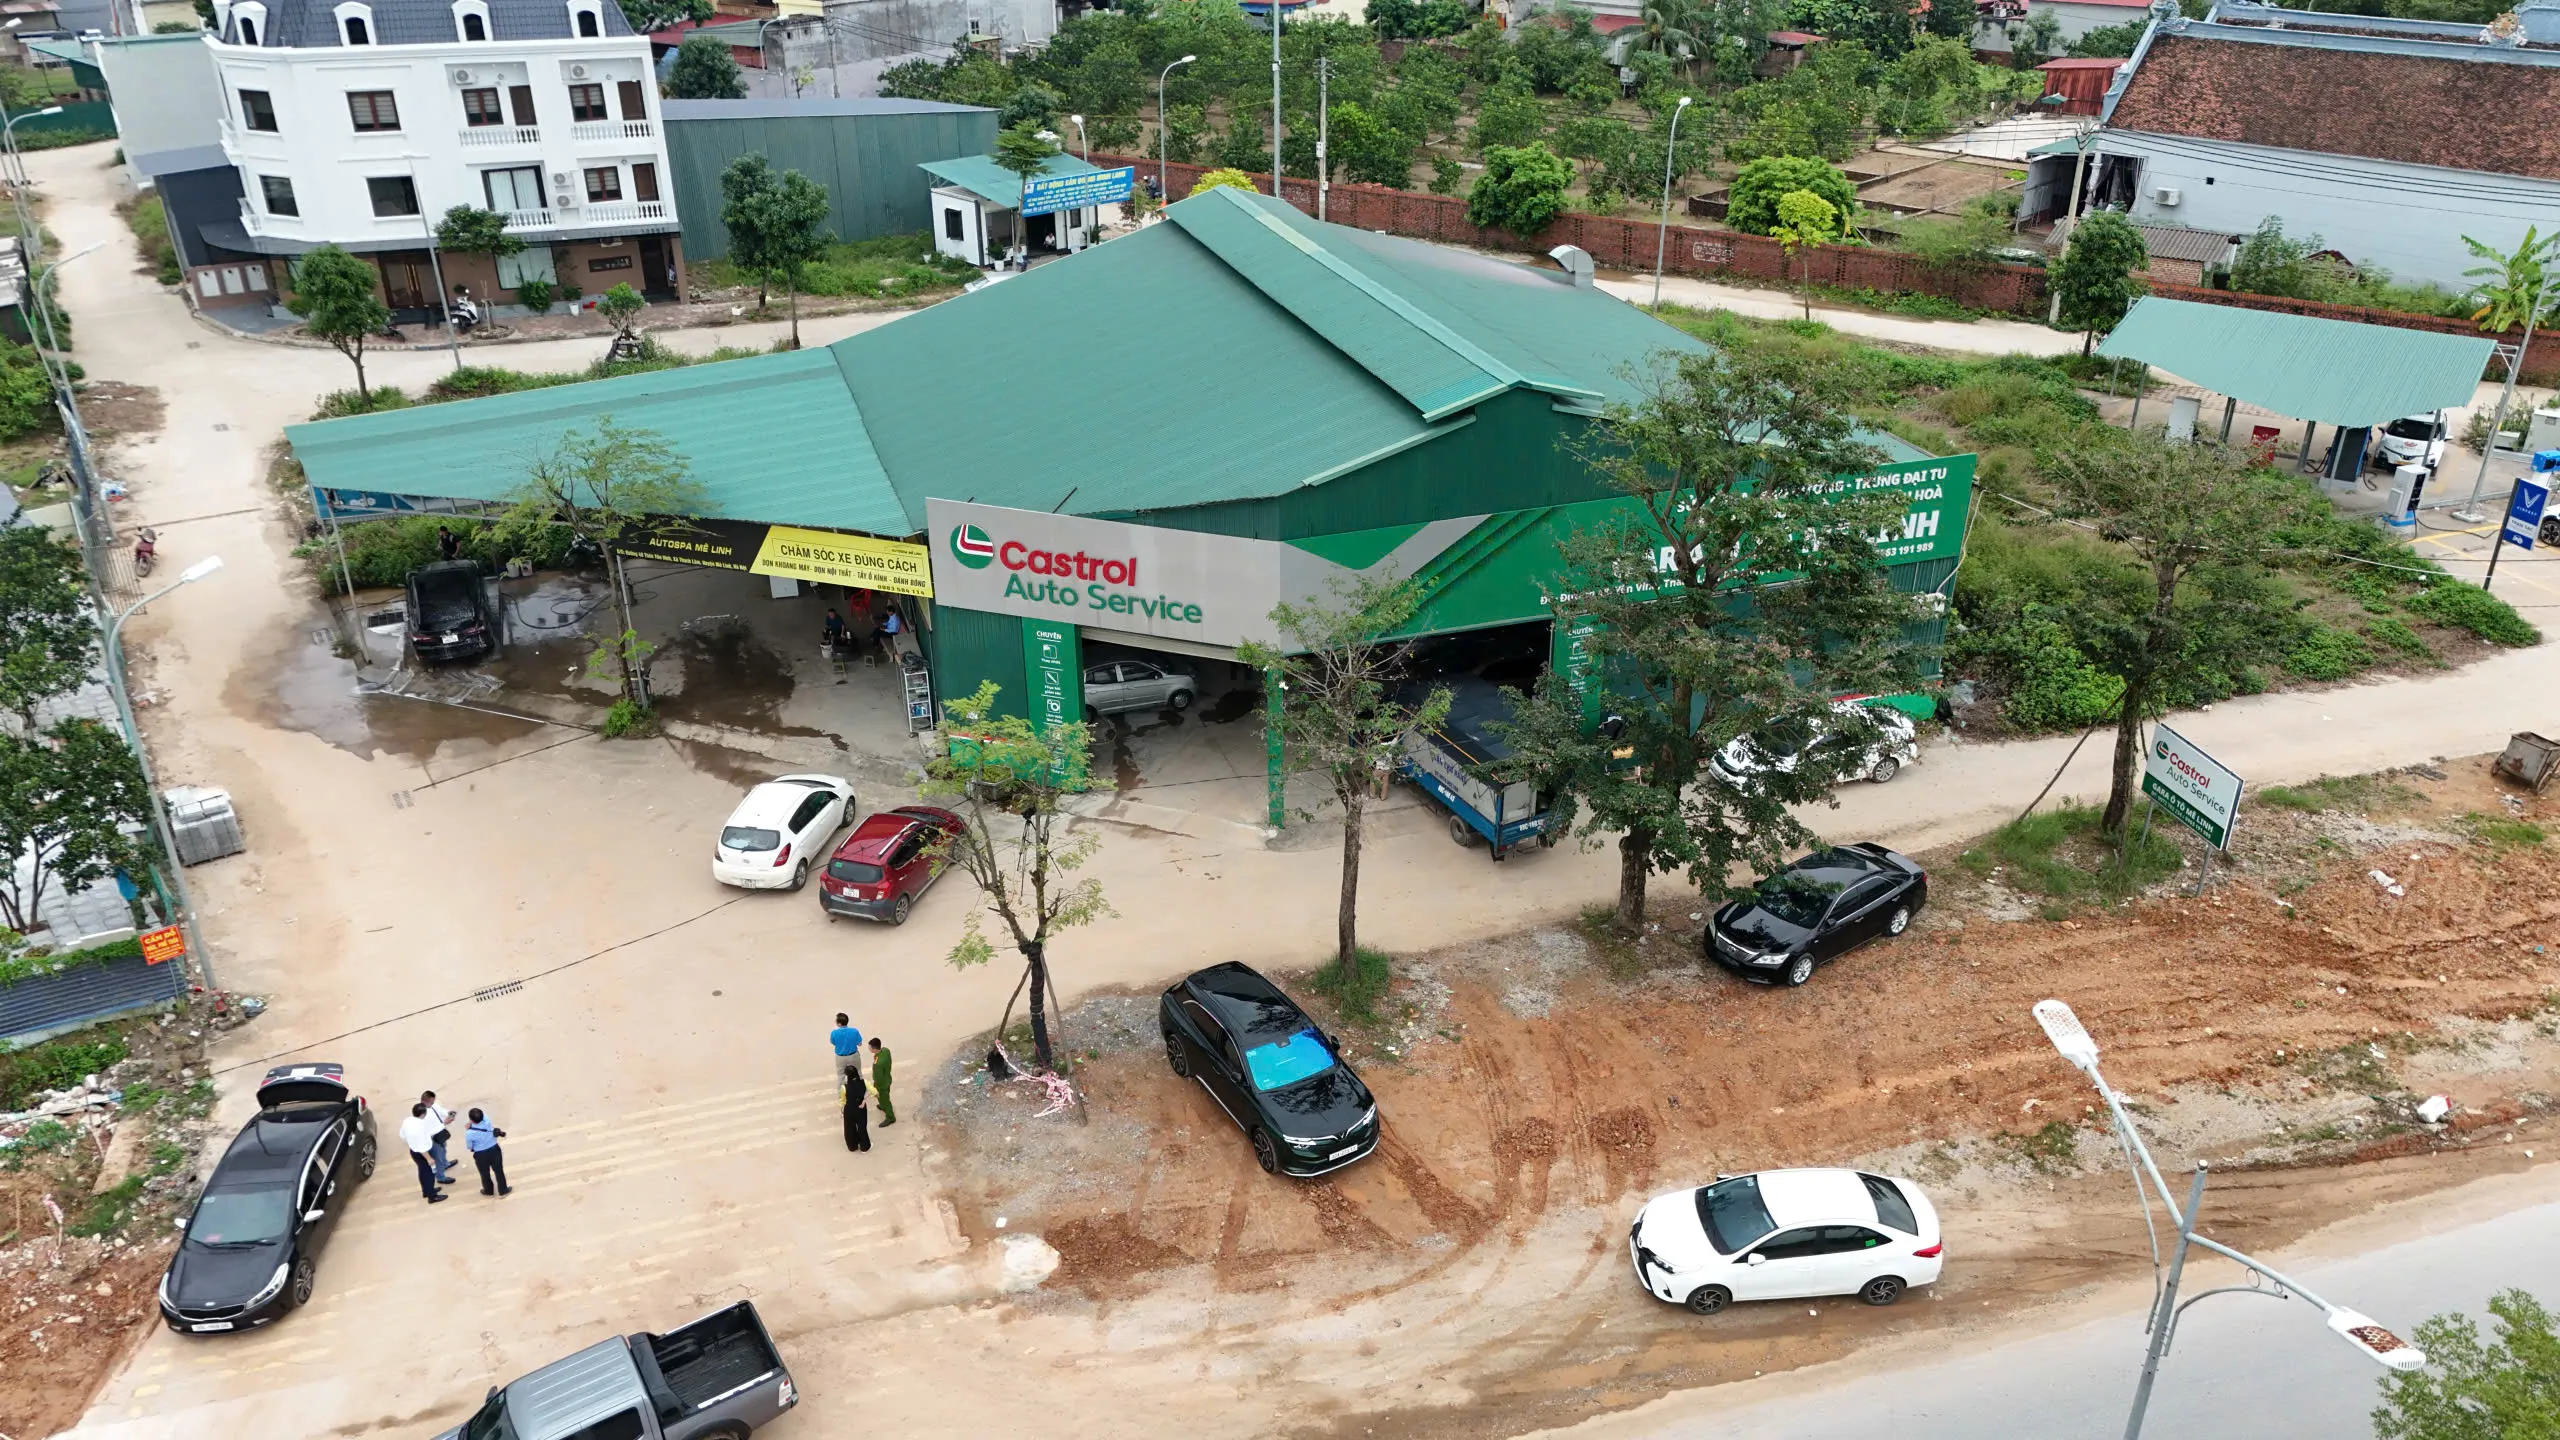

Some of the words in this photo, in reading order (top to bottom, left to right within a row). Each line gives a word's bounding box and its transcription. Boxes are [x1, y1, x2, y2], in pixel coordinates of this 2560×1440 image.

[1902, 470, 1927, 486] ĐẠI
[1930, 467, 1947, 480] TU
[1914, 484, 1942, 501] HOÀ
[649, 537, 692, 551] AUTOSPA
[695, 543, 709, 554] MÊ
[711, 545, 732, 556] LINH
[780, 543, 811, 559] CHĂM
[813, 547, 836, 562] SÓC
[838, 553, 852, 564] XE
[854, 552, 885, 568] ĐÚNG
[887, 557, 917, 573] CÁCH
[1899, 544, 1915, 555] 191
[1917, 541, 1934, 553] 989
[775, 561, 797, 570] KHOANG
[827, 566, 837, 576] NỘI
[999, 540, 1137, 587] Castrol
[1003, 573, 1079, 607] Auto
[1087, 584, 1203, 624] Service
[1036, 630, 1062, 640] CHUYÊN
[2169, 752, 2211, 789] Castrol
[2166, 766, 2189, 788] Auto
[2190, 783, 2225, 815] Service
[2152, 782, 2170, 800] GARA
[2170, 794, 2176, 804] Ô
[2176, 799, 2185, 811] TÔ
[2186, 807, 2197, 820] MÊ
[2196, 815, 2214, 833] LINH
